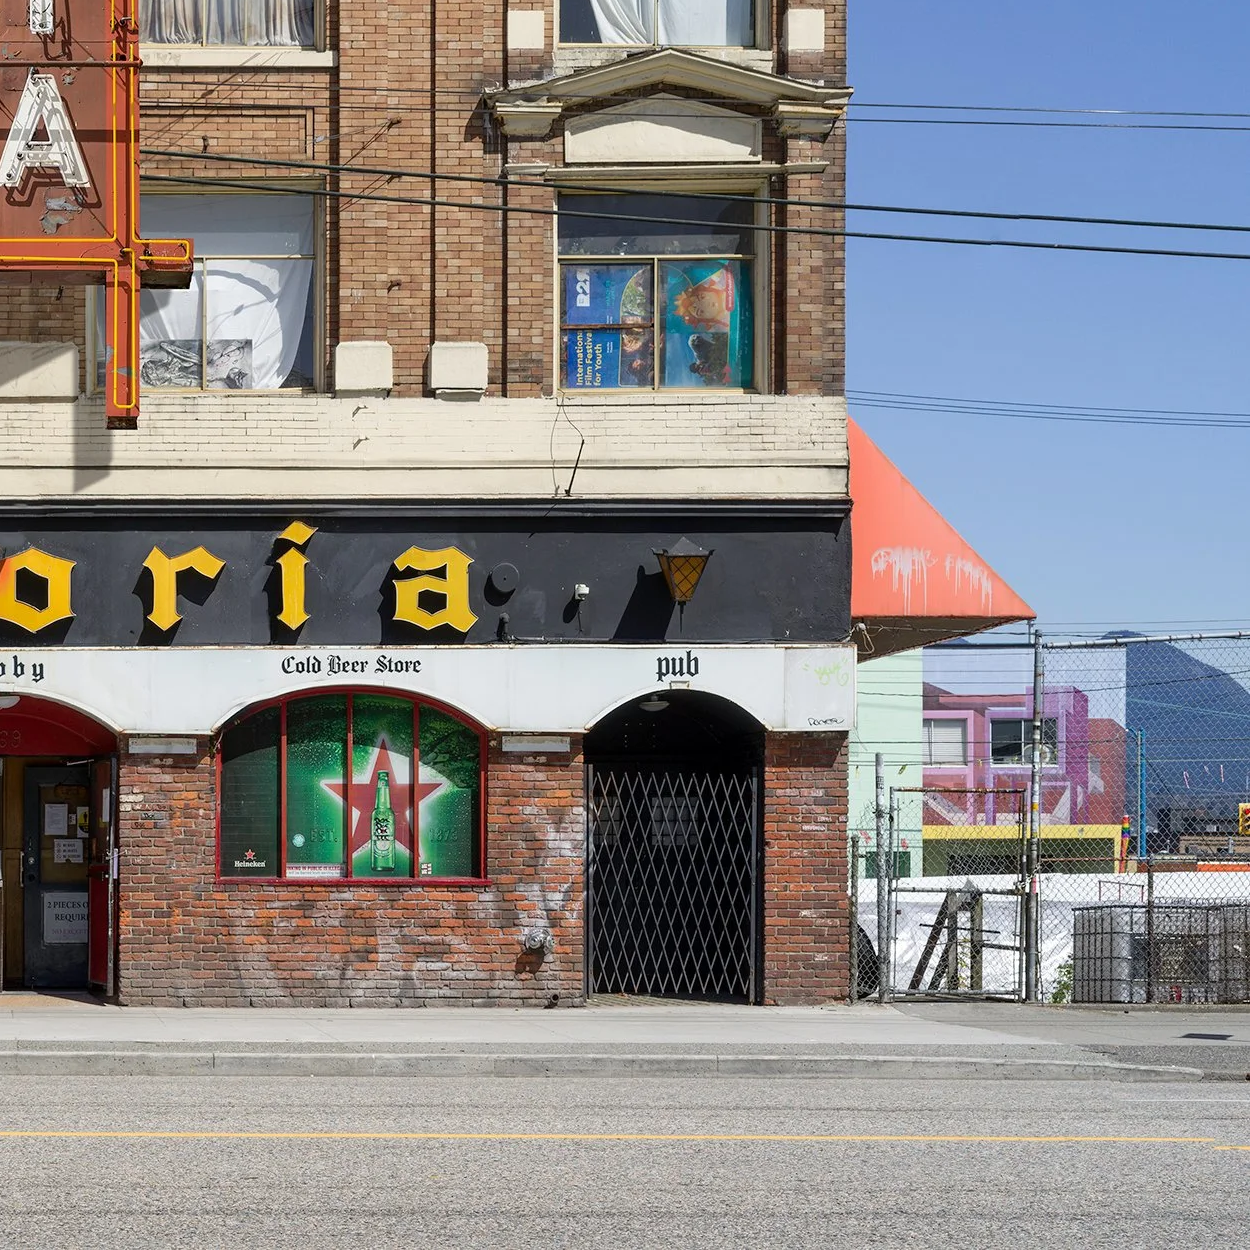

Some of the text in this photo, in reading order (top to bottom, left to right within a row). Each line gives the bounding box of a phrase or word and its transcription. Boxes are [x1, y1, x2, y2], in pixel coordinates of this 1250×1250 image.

[575, 330, 584, 386] Internationa
[594, 343, 602, 387] for Youth
[585, 366, 593, 386] Film
[281, 654, 422, 676] Cold Beer Store
[655, 649, 699, 683] pub
[234, 860, 266, 868] Heineken
[47, 901, 52, 909] 2
[53, 901, 81, 909] PIECES
